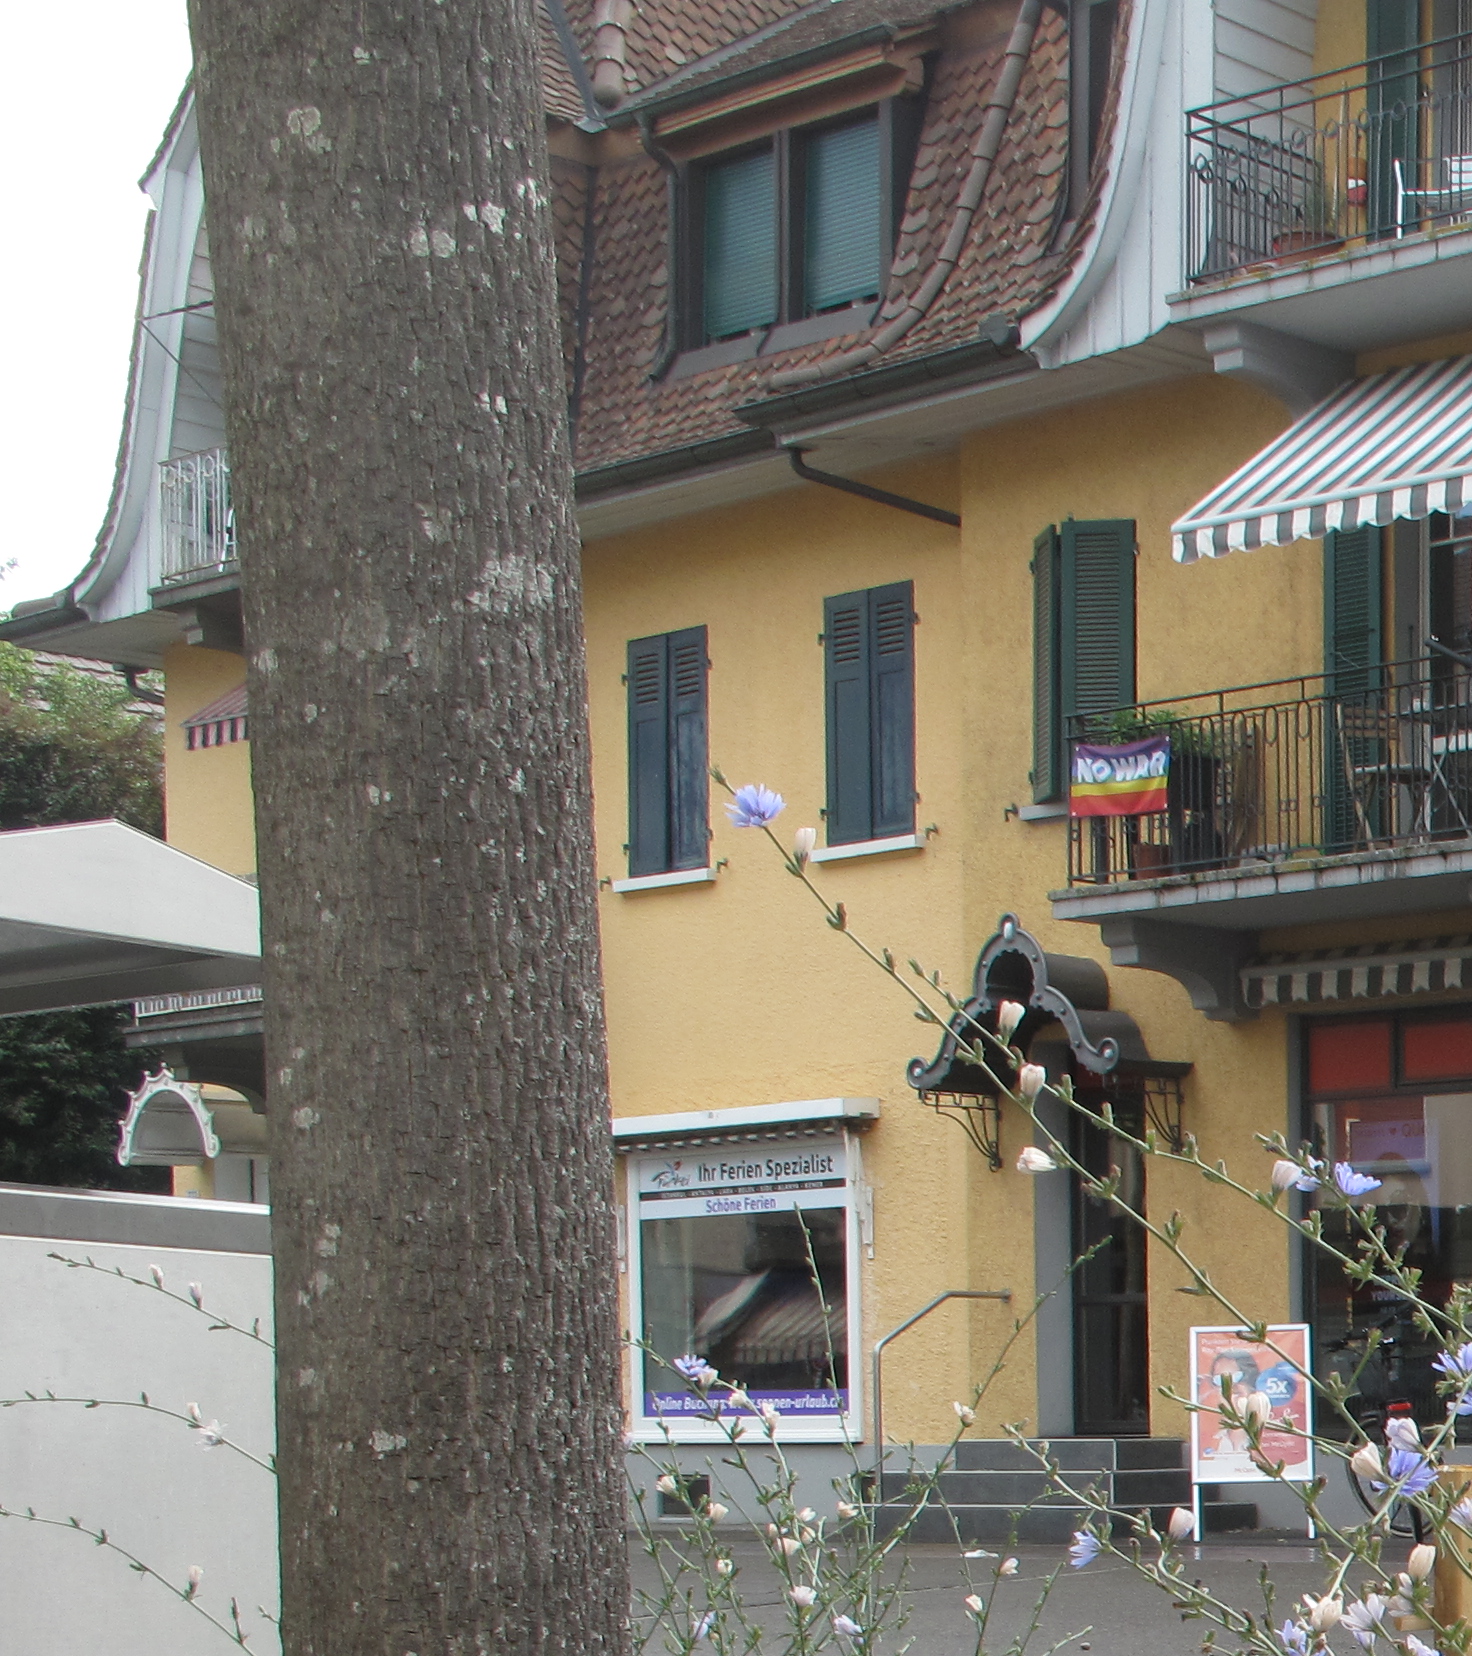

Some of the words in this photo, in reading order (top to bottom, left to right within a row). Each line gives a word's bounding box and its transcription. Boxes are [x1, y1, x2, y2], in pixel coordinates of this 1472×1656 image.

[1077, 757, 1112, 784] NO
[1110, 750, 1165, 782] WAR
[698, 1162, 716, 1183] Ihr
[720, 1160, 763, 1181] Ferien
[765, 1154, 834, 1180] Spezialist
[706, 1197, 742, 1214] Schöne
[744, 1195, 777, 1212] Ferien
[1265, 1377, 1288, 1394] 5x
[652, 1396, 682, 1411] Online
